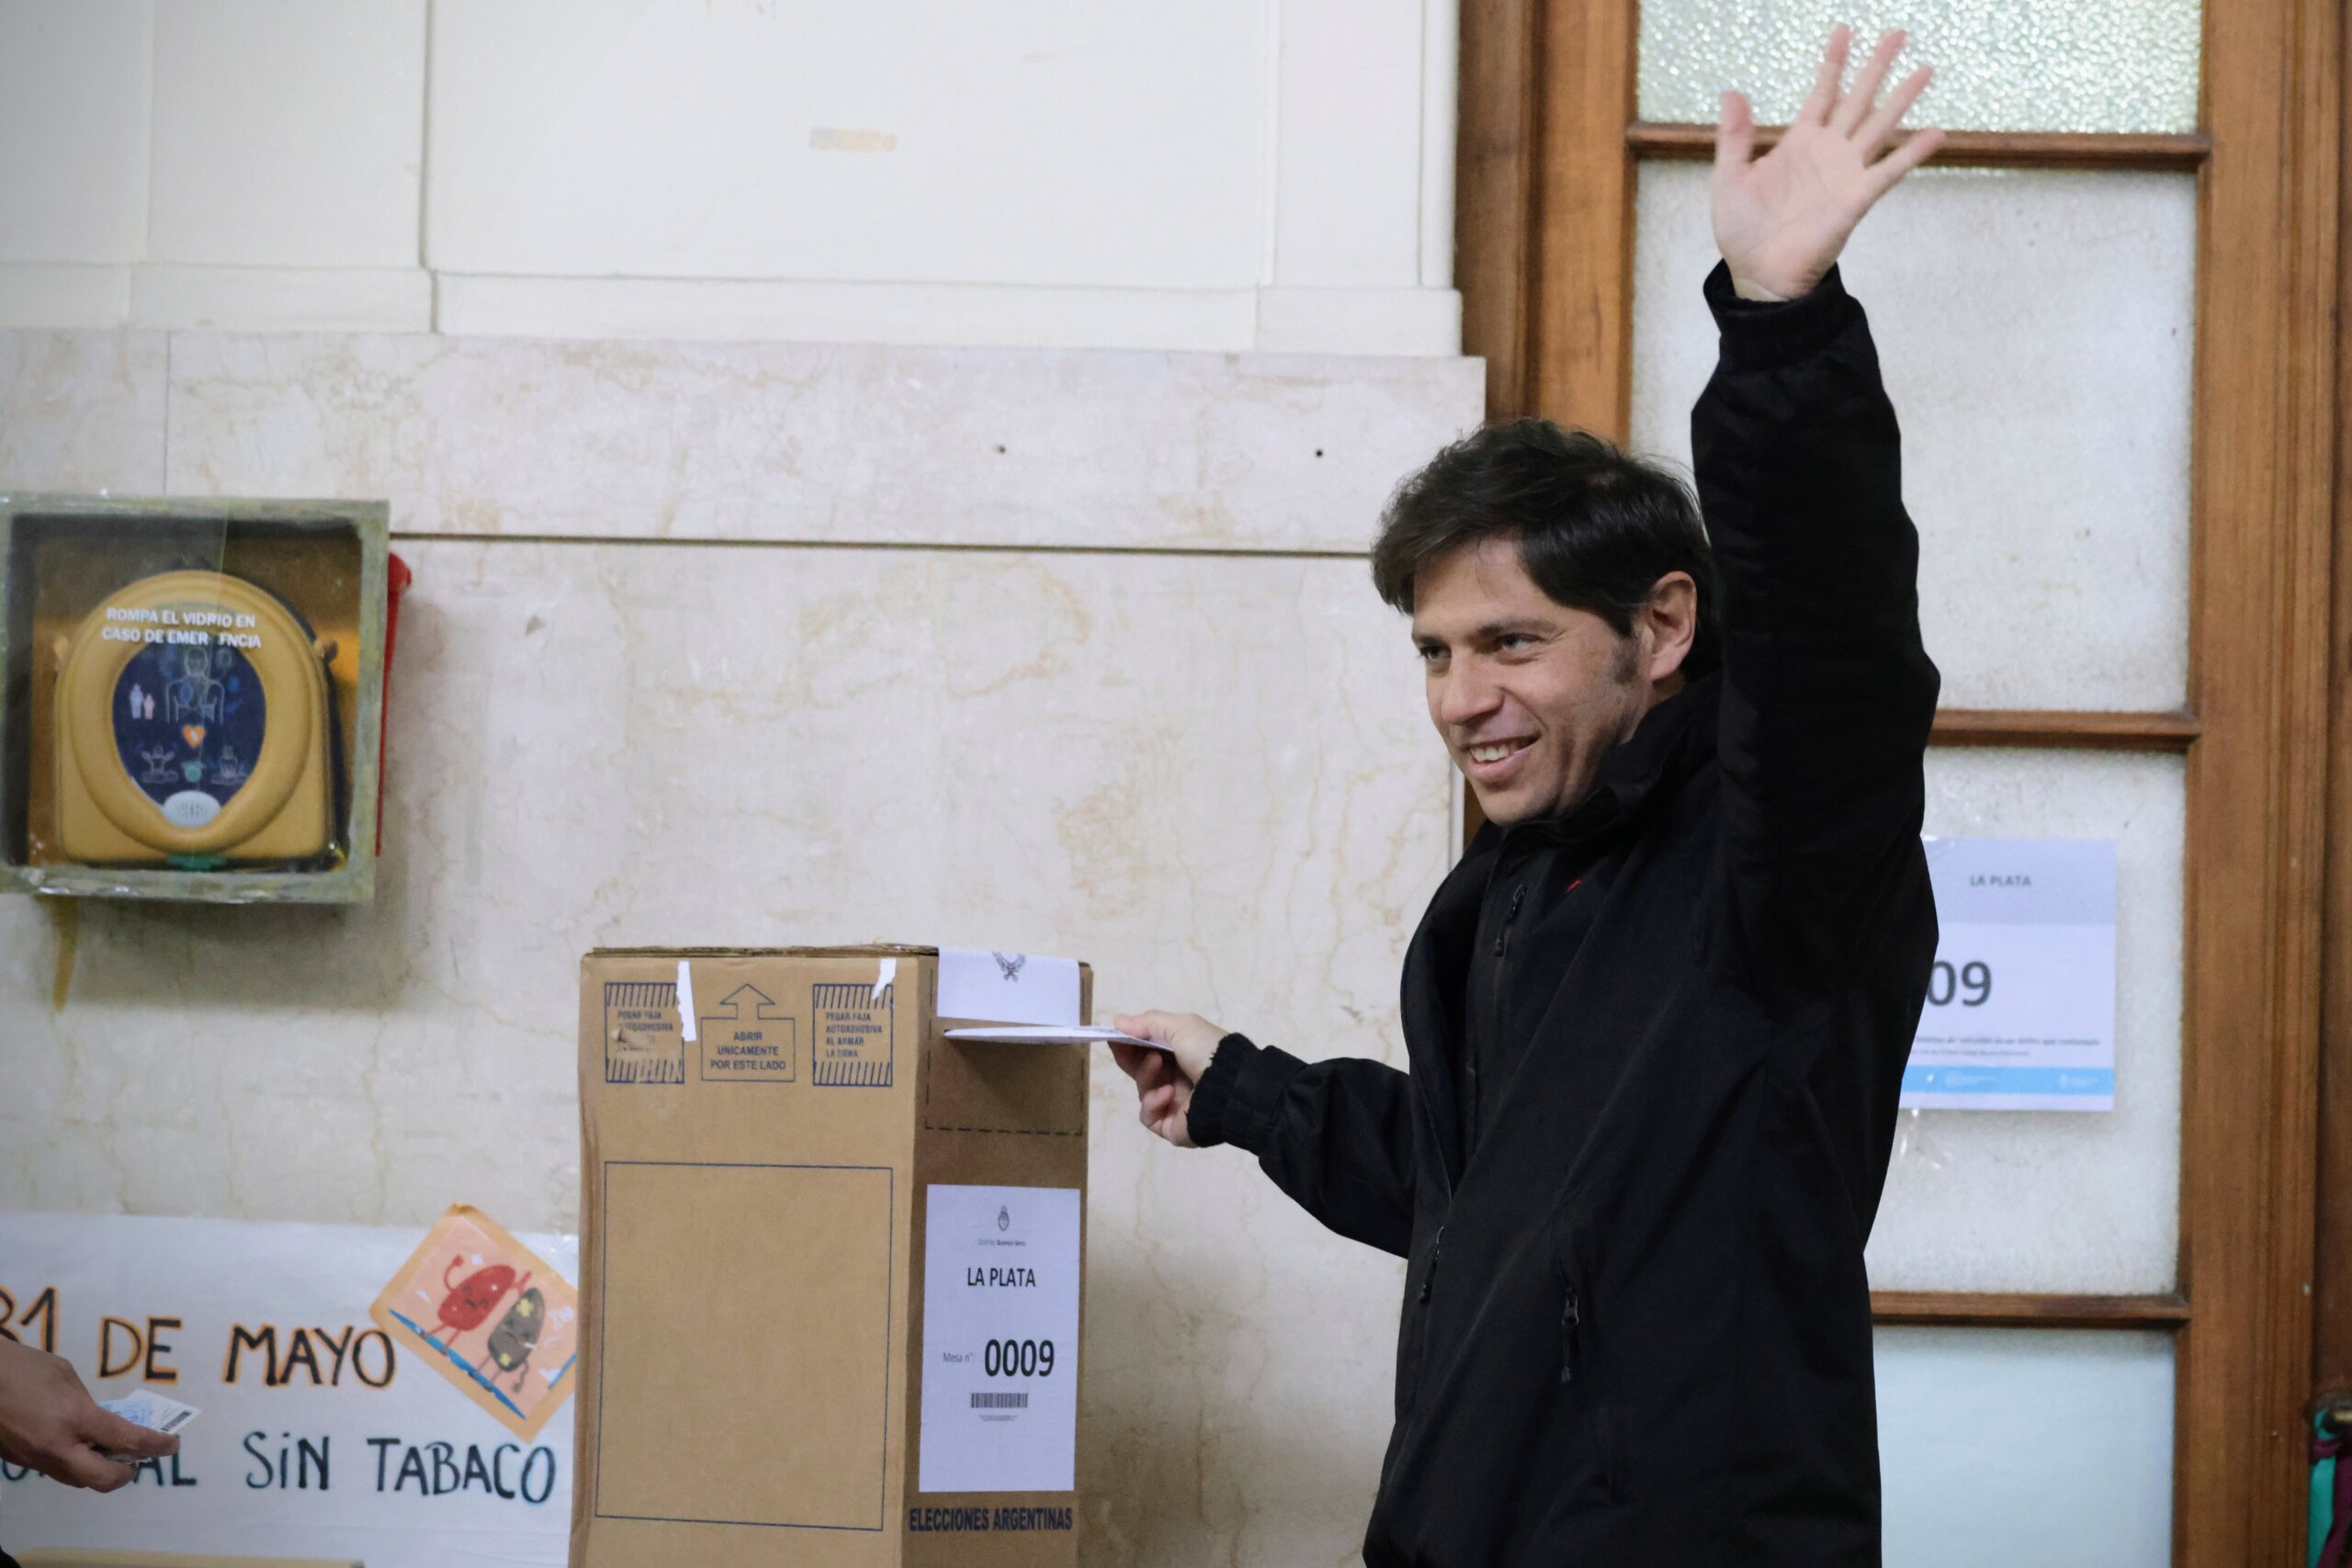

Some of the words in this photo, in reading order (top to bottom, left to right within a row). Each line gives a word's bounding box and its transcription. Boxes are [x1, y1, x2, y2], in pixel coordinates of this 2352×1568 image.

[106, 607, 158, 623] ROMPA
[162, 610, 179, 625] EL
[184, 612, 232, 627] VIDRIO
[235, 614, 255, 627] EN
[103, 627, 141, 641] CASO
[144, 629, 164, 643] DE
[1970, 875, 1985, 886] LA
[1990, 875, 2032, 887] PLATA
[825, 1012, 851, 1021] PEGAR
[853, 1012, 871, 1021] FAJA
[733, 1032, 763, 1041] ABRIR
[825, 1024, 882, 1033] AUTOADHESIVA
[718, 1045, 779, 1056] UNICAMENTE
[710, 1060, 731, 1070] POR
[733, 1060, 757, 1070] ESTE
[760, 1061, 786, 1071] LADO
[967, 1267, 985, 1286] LA
[989, 1267, 1035, 1287] PLATA
[98, 1315, 183, 1383] DE
[223, 1323, 397, 1389] MAYO
[984, 1338, 1055, 1377] 0009
[368, 1436, 557, 1506] TABACO
[909, 1508, 989, 1532] ELECCIONES
[992, 1507, 1073, 1531] ARGENTINAS
